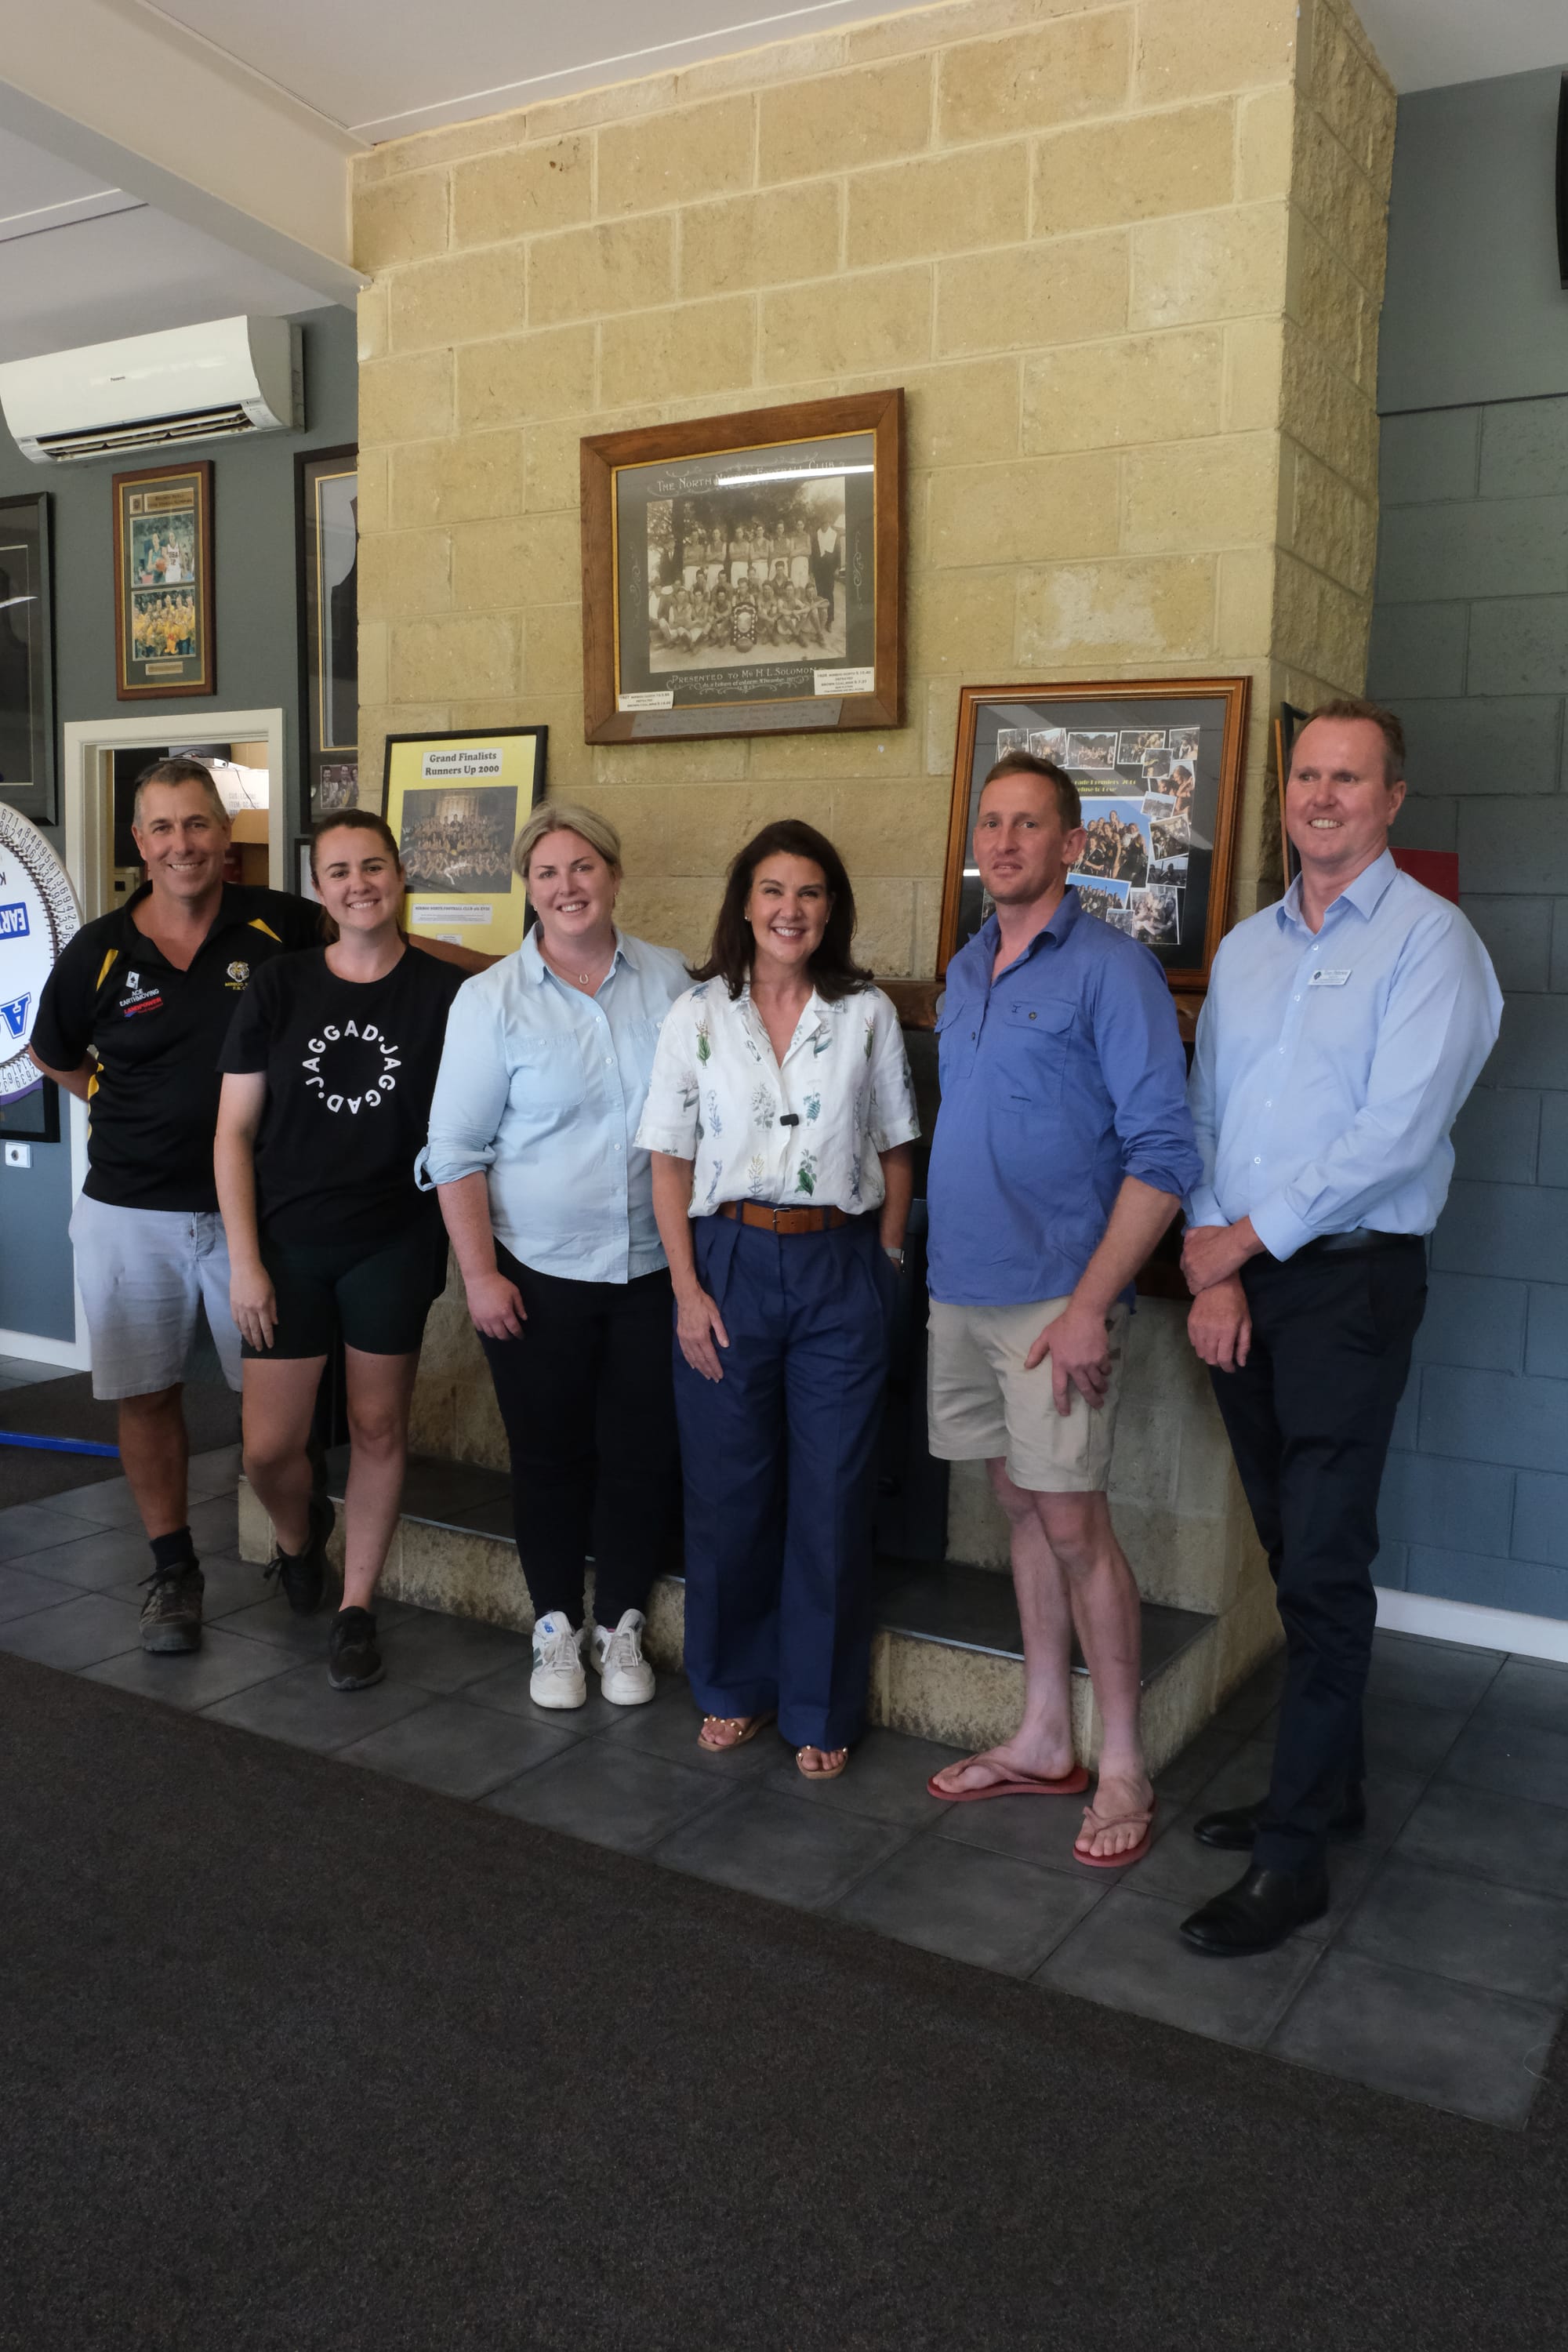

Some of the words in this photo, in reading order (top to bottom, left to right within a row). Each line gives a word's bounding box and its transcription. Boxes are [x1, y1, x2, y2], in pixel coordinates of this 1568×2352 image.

[672, 673, 723, 684] PRESENTED
[430, 753, 456, 763] Grand
[459, 753, 497, 761] Finalists
[425, 767, 462, 775] Runners
[464, 765, 477, 775] Up
[132, 988, 143, 996] ACE
[119, 989, 159, 1007] EARTHMOVING
[124, 996, 162, 1014] LANDPOWER
